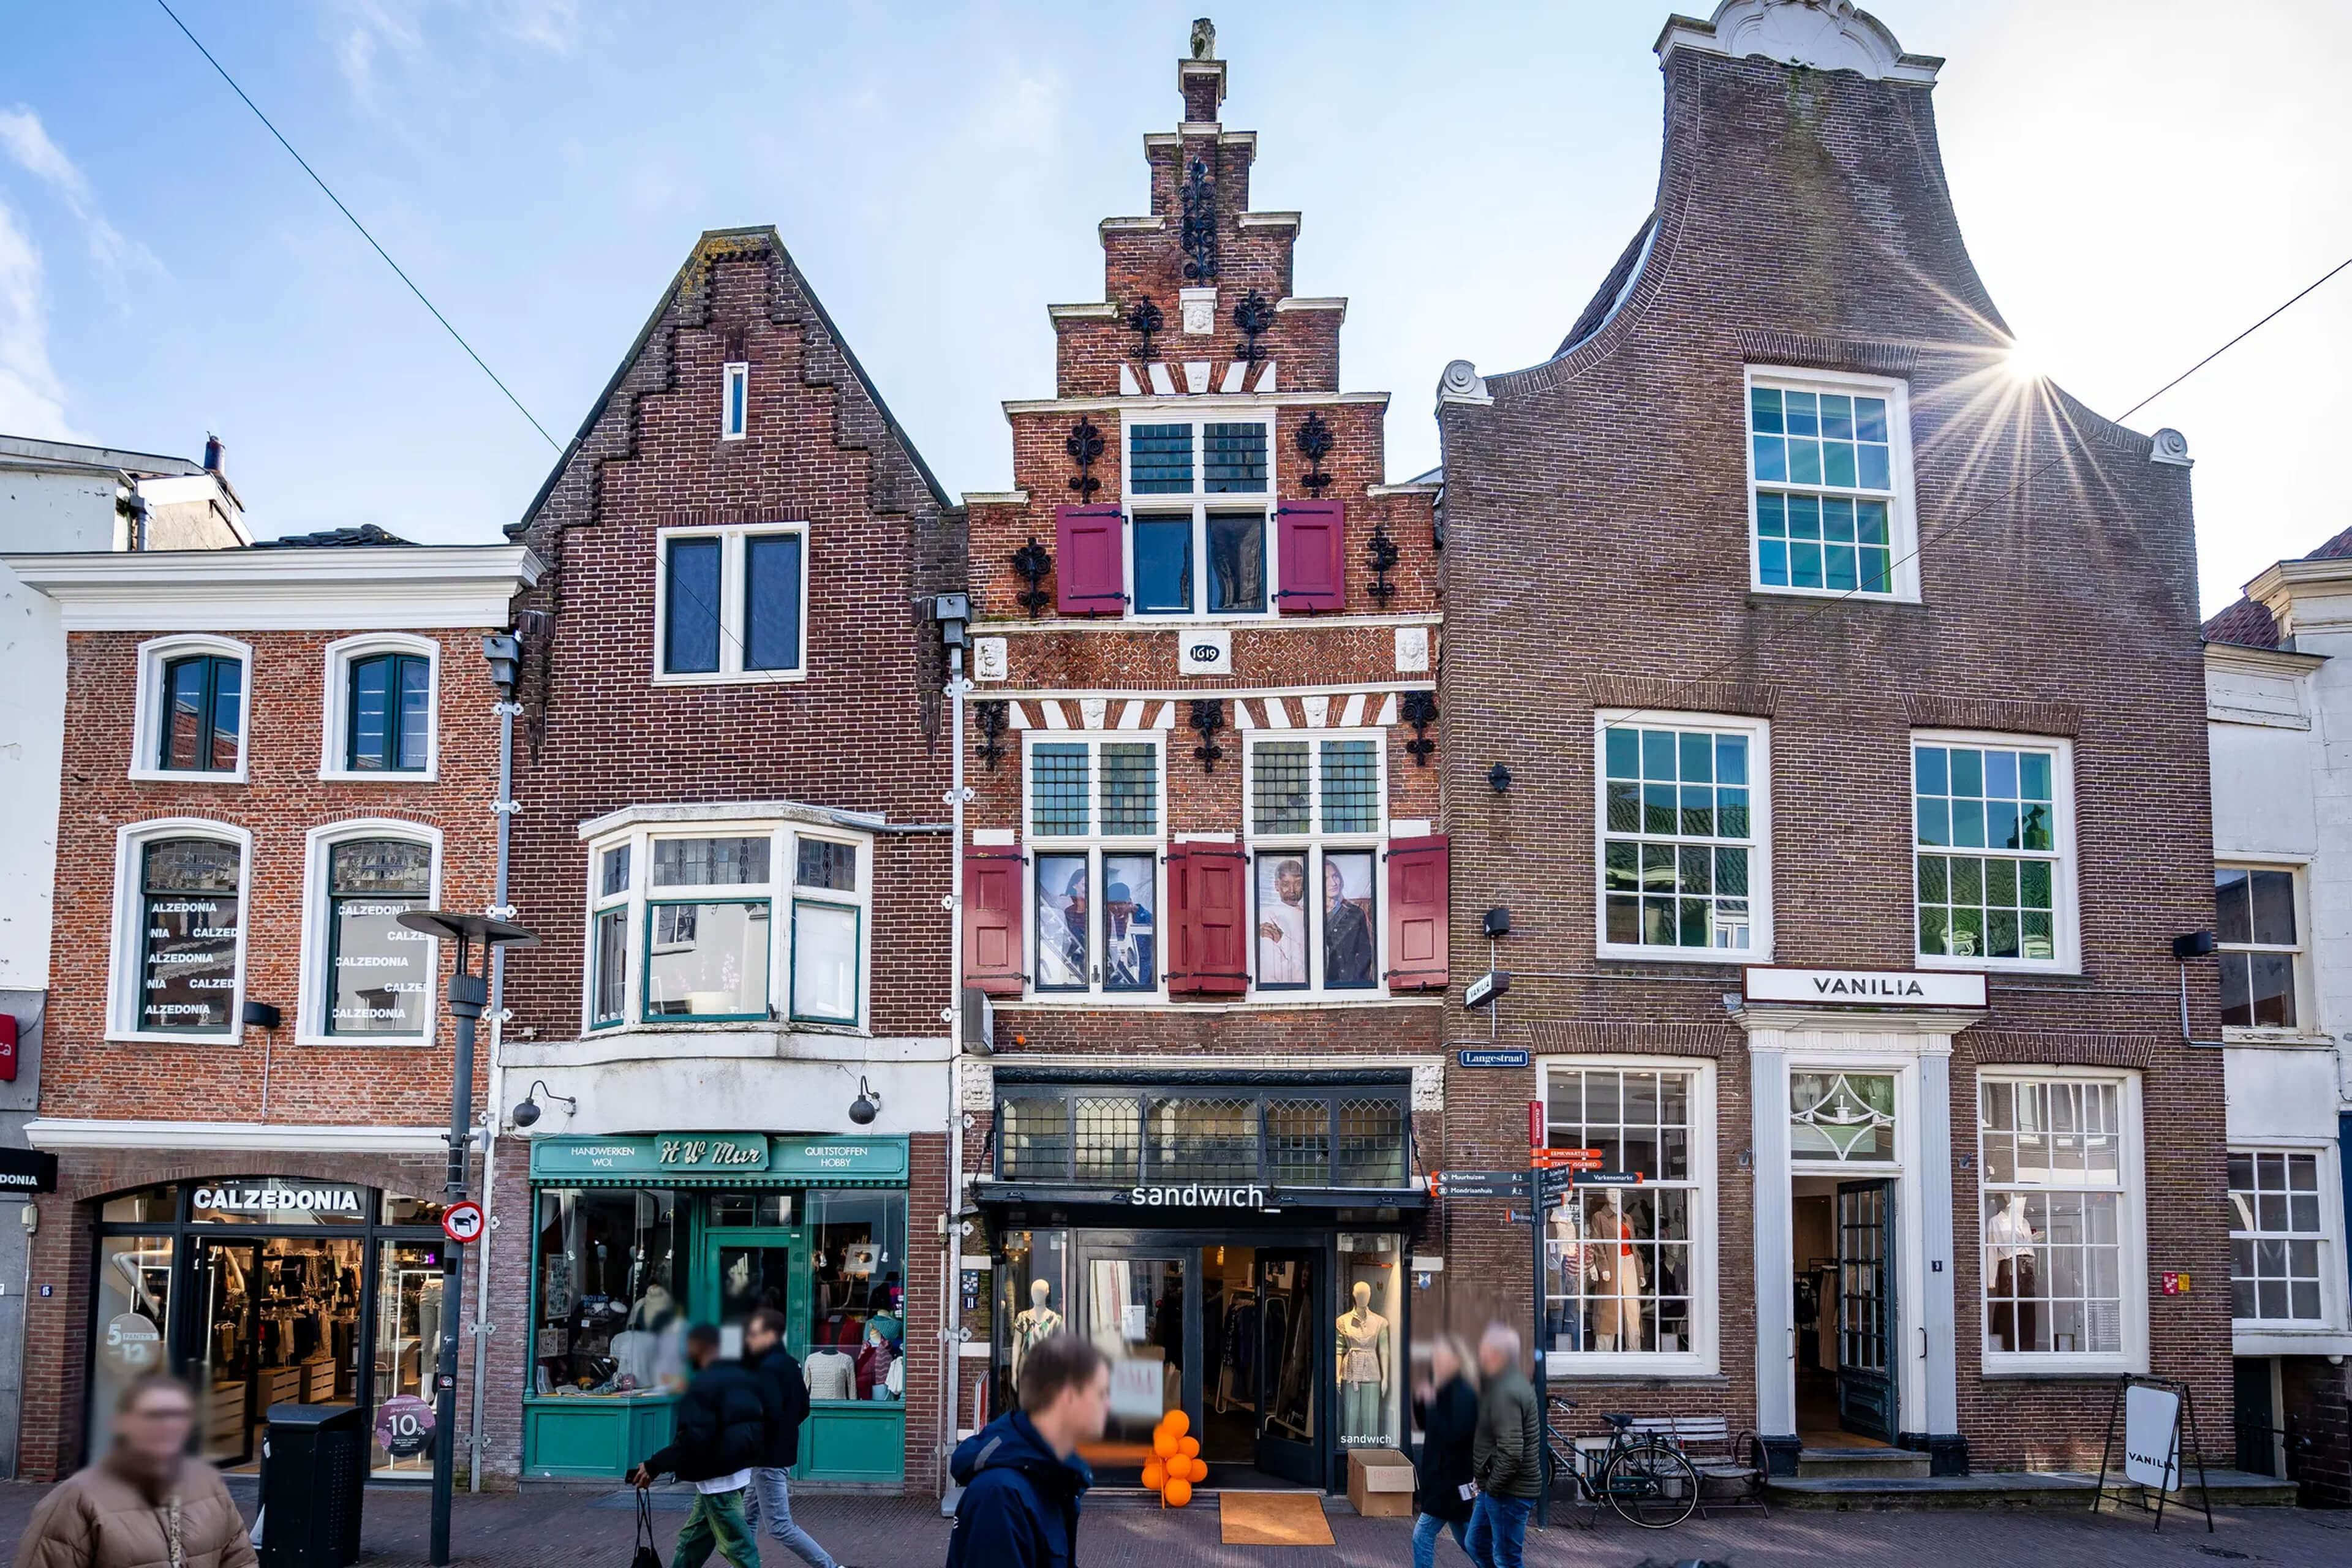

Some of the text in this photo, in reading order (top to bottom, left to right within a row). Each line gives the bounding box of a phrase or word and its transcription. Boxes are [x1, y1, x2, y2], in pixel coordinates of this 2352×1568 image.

[1193, 647, 1216, 660] 1619
[152, 903, 217, 912] ALZEDONIA
[387, 932, 428, 941] CALZE
[148, 954, 213, 963] ALZEDONIA
[336, 957, 409, 966] CALZEDONIA
[1470, 980, 1490, 998] VANILIA
[1812, 978, 1924, 995] VANILIA
[145, 1005, 210, 1014] ALZEDONIA
[333, 1009, 405, 1018] CALZEDONIA
[1466, 1053, 1523, 1065] Langestraat
[571, 1147, 635, 1156] HANDWERKEN
[805, 1147, 868, 1156] QUILTSTOFFEN
[592, 1158, 614, 1167] WOL
[821, 1158, 851, 1167] HOBBY
[0, 1174, 38, 1185] DONIA
[194, 1189, 358, 1210] CALZEDONIA
[107, 1324, 122, 1346] 5
